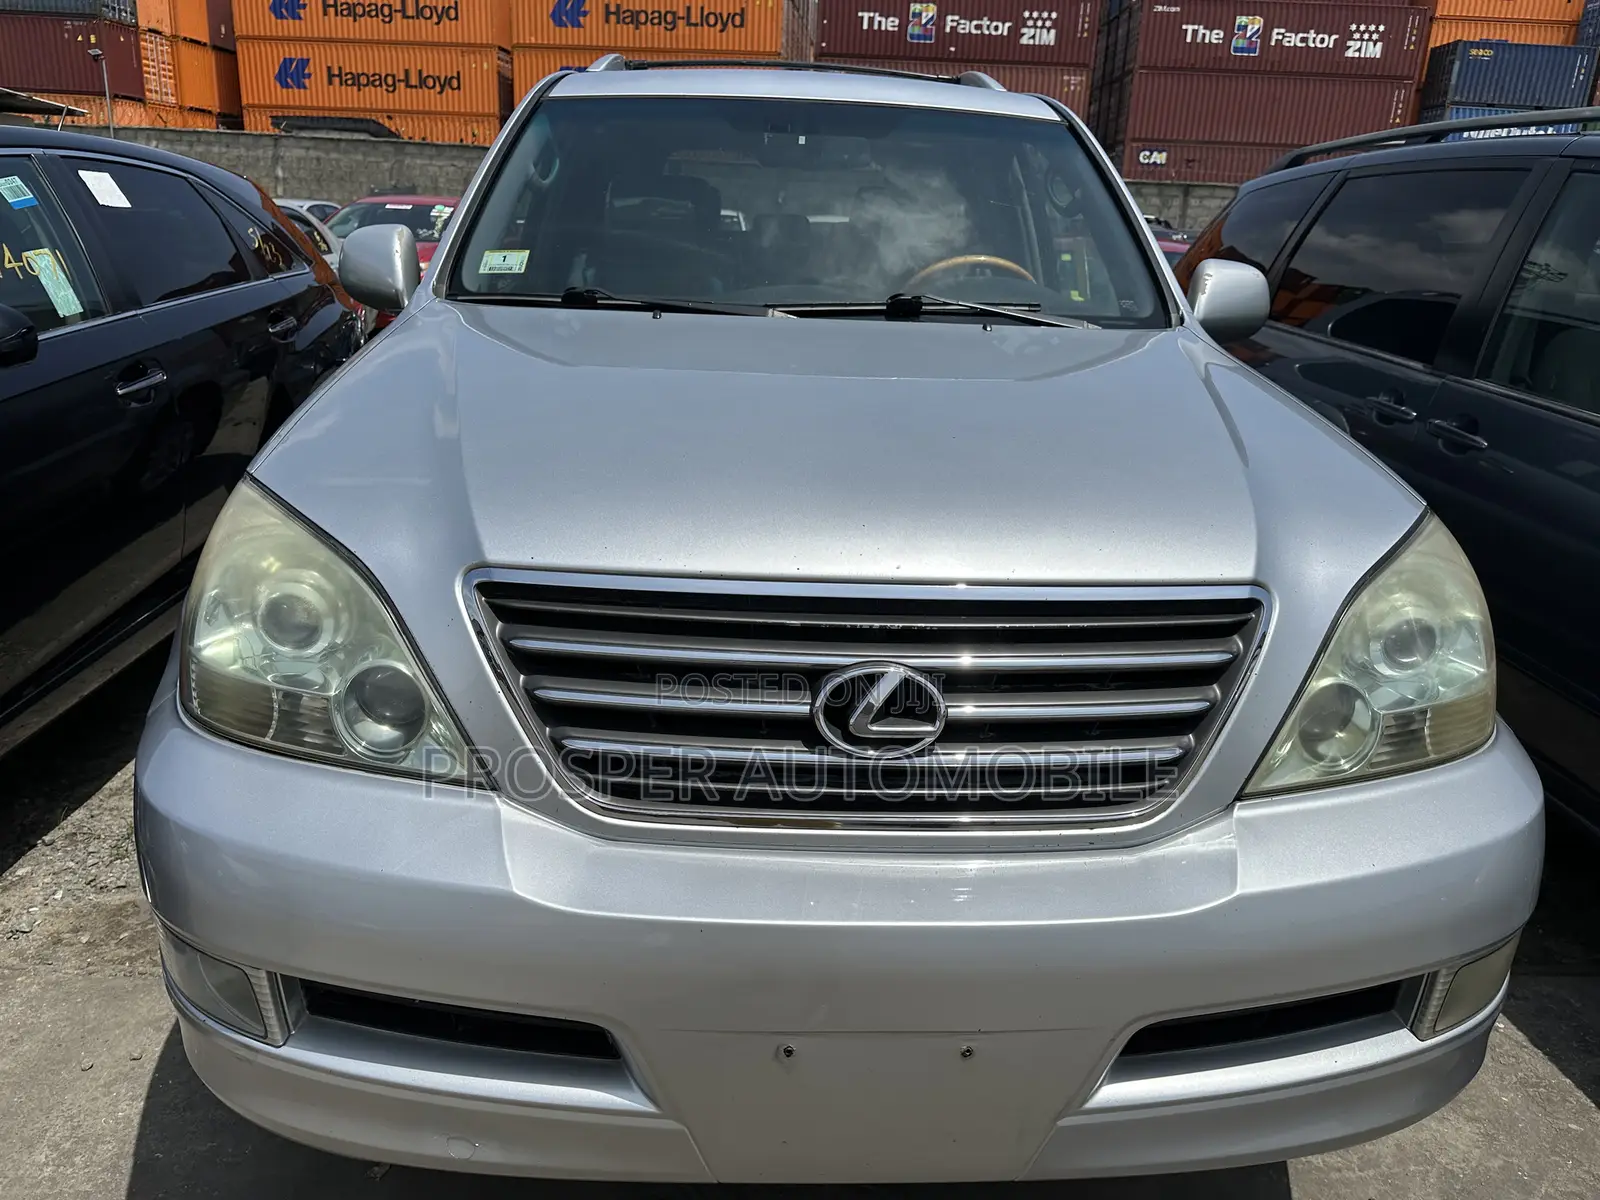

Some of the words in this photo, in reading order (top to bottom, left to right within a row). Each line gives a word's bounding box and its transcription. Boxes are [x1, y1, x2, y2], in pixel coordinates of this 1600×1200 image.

[322, 0, 459, 25] Hapag-Lloyd
[604, 3, 745, 33] Hapag-Lloyd
[857, 11, 900, 32] The
[945, 15, 1012, 36] Factor
[1019, 27, 1057, 46] ZIM
[1181, 23, 1225, 44] The
[1270, 28, 1339, 49] Factor
[1344, 40, 1384, 59] ZIM
[326, 65, 461, 95] Hapag-Lloyd
